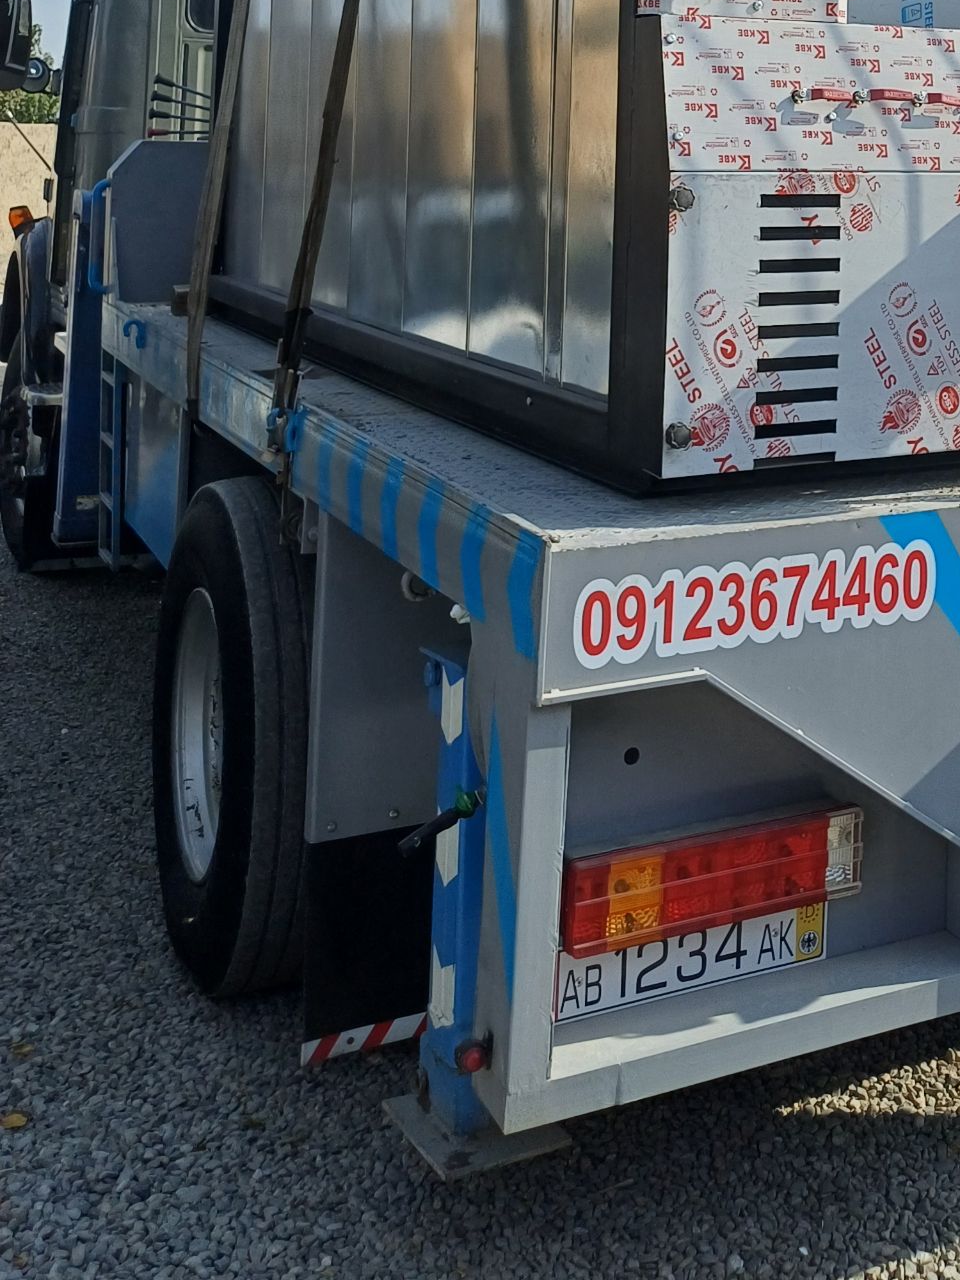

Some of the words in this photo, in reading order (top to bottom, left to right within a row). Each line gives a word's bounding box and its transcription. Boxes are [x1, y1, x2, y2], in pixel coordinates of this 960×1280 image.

[924, 1, 933, 29] STEE
[739, 309, 764, 350] STEEL
[928, 299, 952, 340] STEEL
[666, 338, 702, 403] STEEL
[864, 328, 897, 389] STEEL
[580, 549, 928, 656] 09123674460
[560, 964, 602, 1013] AB
[614, 920, 747, 999] 1234
[757, 917, 794, 965] AK
